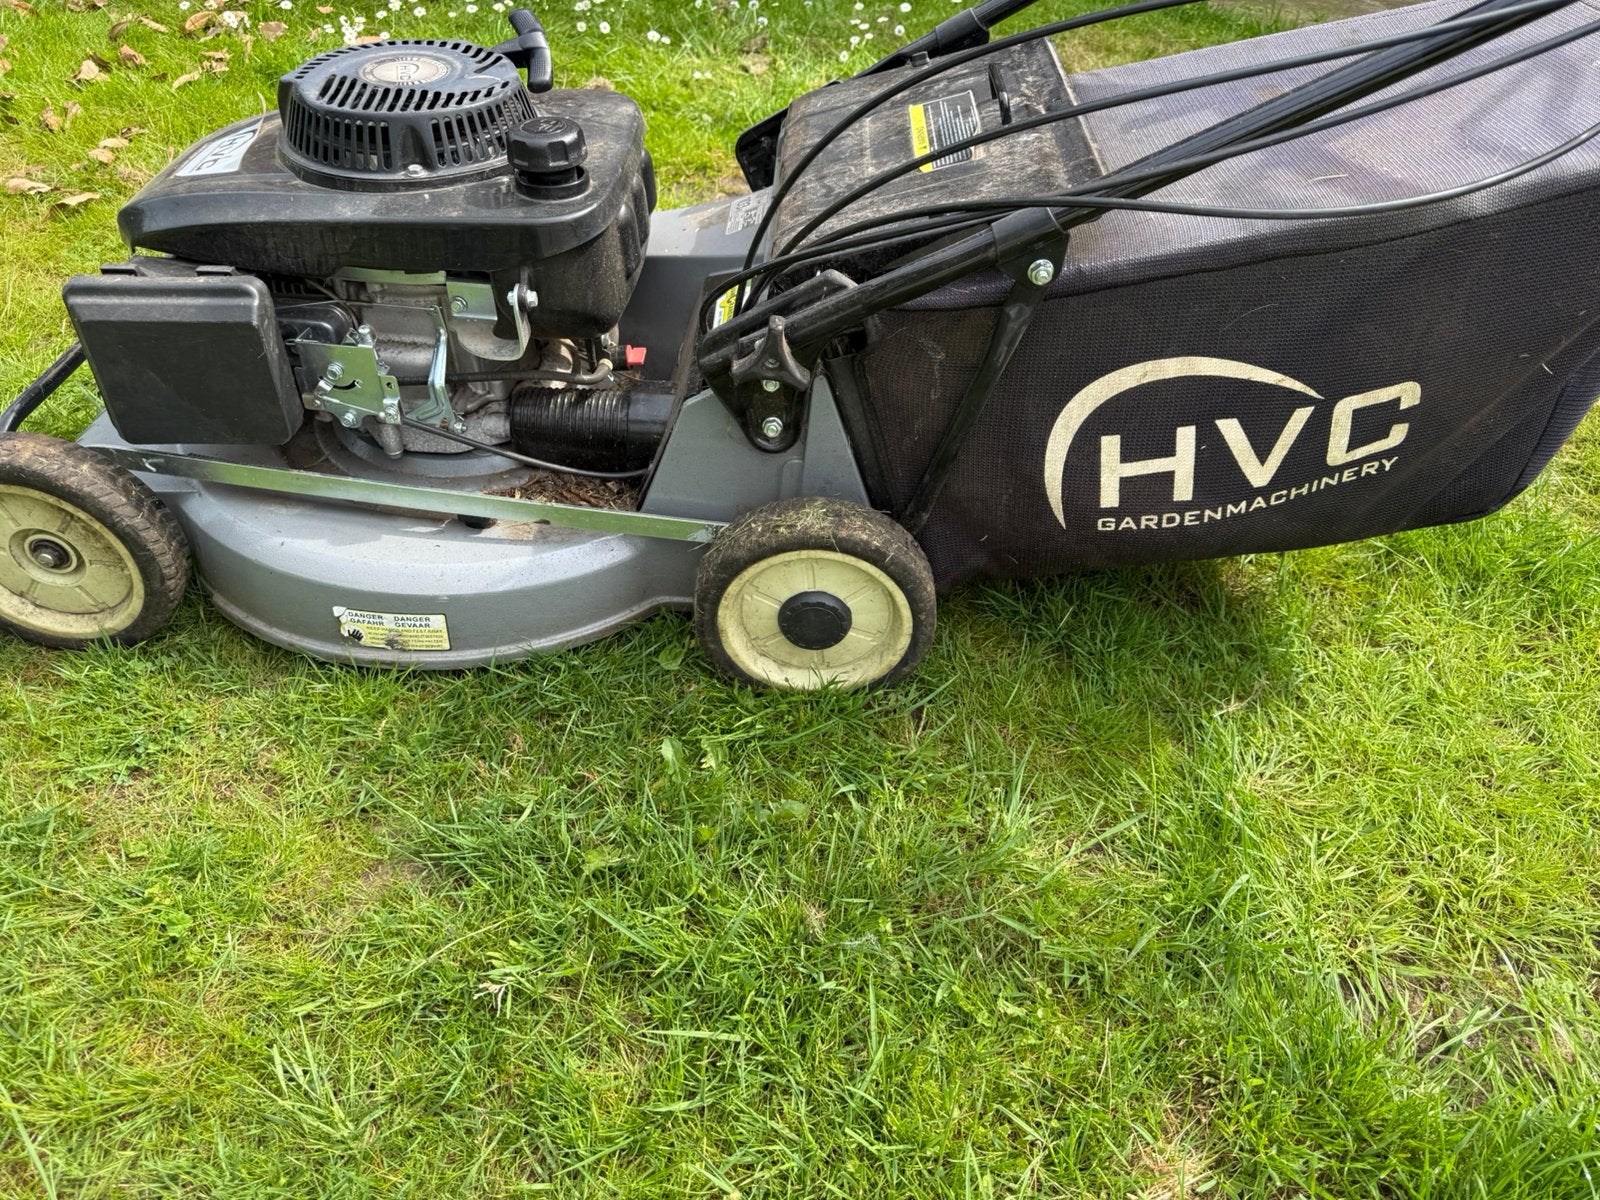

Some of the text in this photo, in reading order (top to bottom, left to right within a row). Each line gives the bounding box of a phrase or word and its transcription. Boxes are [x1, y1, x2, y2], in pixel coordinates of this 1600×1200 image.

[1099, 380, 1422, 508] HVC
[1097, 455, 1398, 531] GARDENMACHINERY
[348, 611, 384, 620] DANGER
[350, 618, 385, 626] GAFAHR
